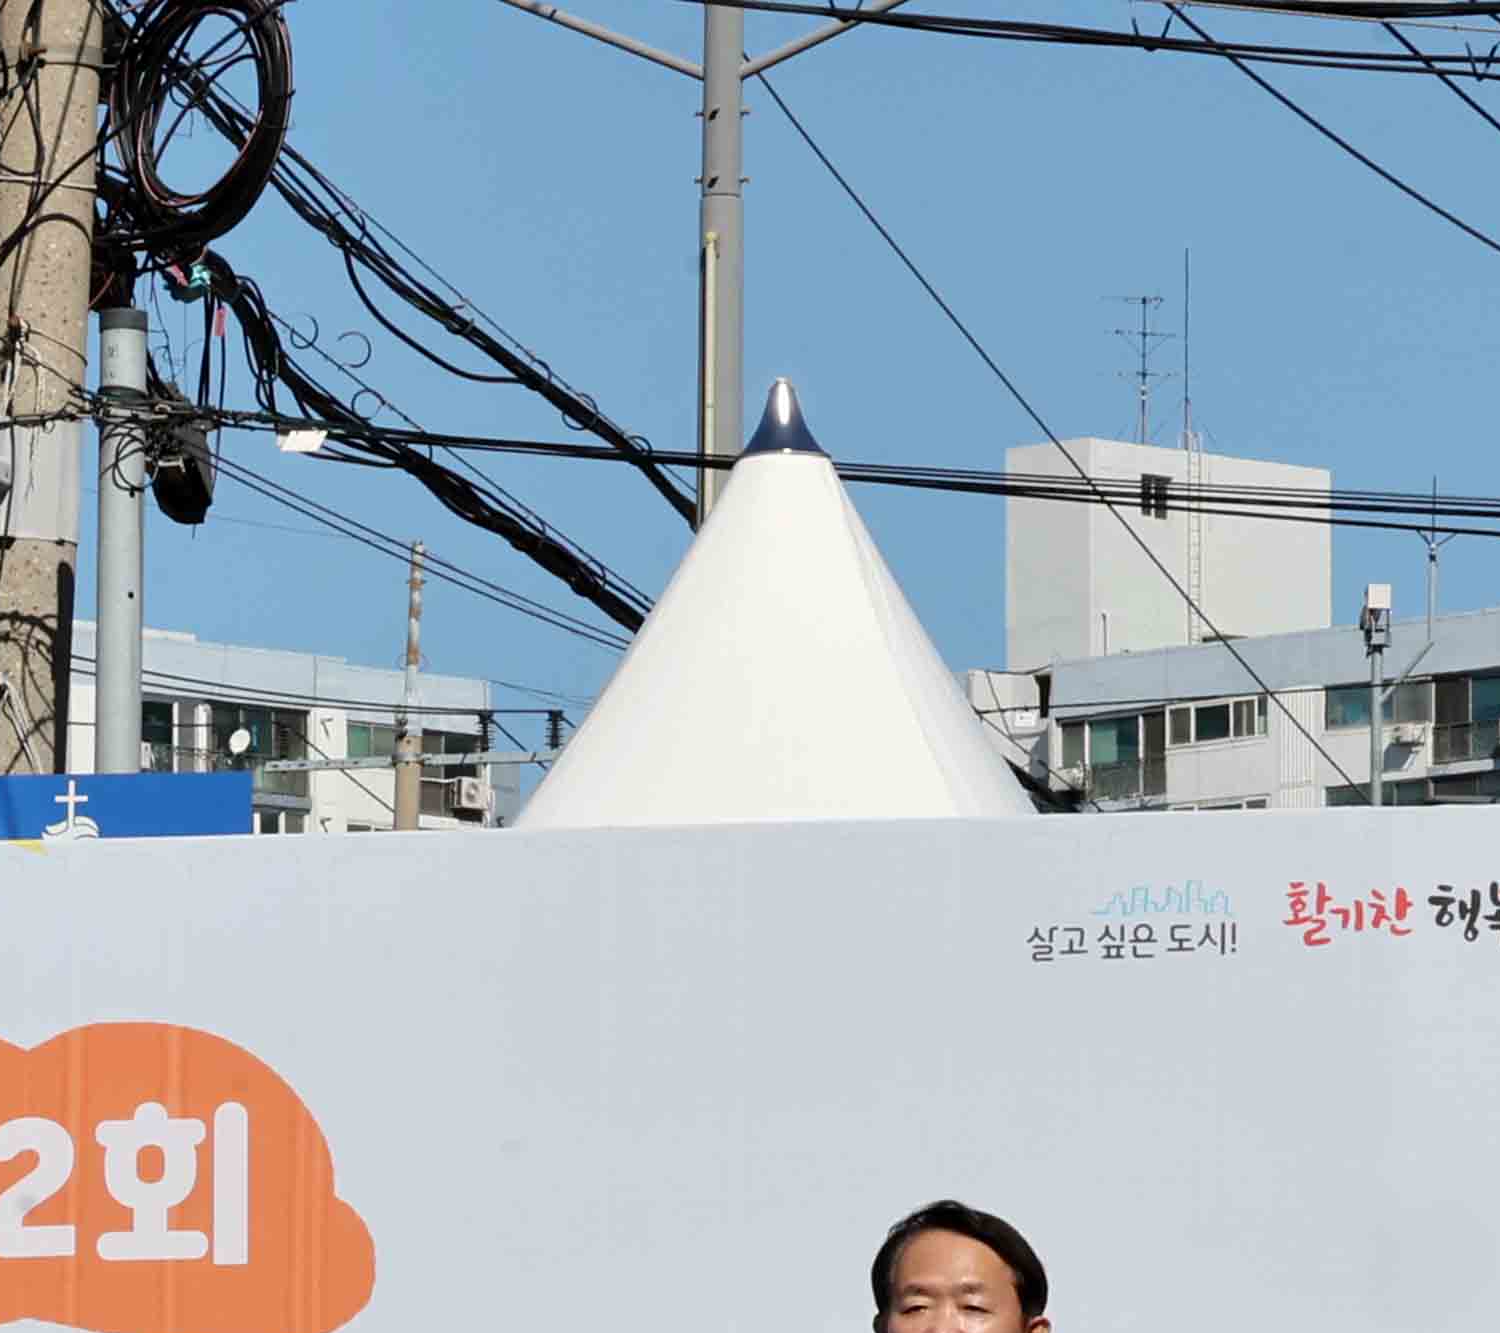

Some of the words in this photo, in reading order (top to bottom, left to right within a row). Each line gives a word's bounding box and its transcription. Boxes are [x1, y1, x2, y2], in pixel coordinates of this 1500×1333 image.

[1282, 880, 1413, 947] 활기찬
[1026, 922, 1088, 961] 살고
[1096, 922, 1159, 960] 싶은
[1166, 921, 1238, 957] 도시!
